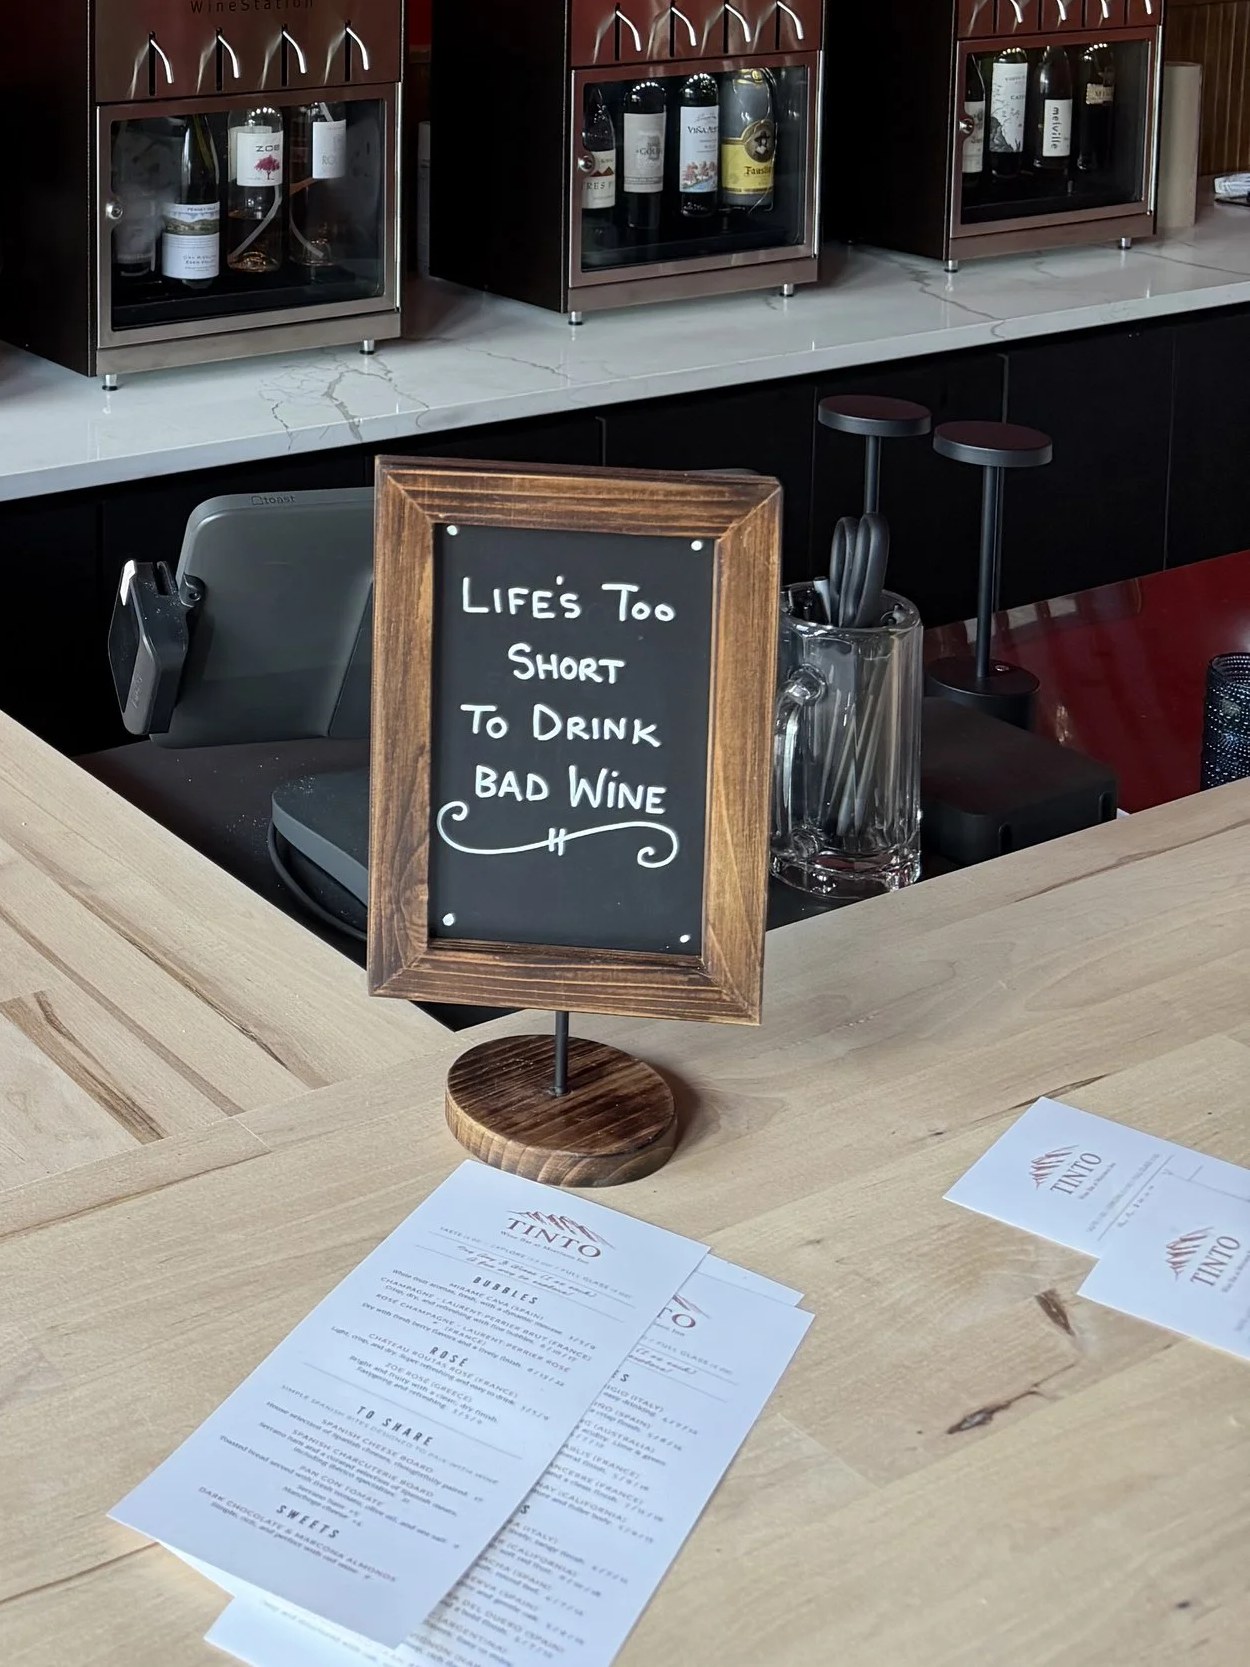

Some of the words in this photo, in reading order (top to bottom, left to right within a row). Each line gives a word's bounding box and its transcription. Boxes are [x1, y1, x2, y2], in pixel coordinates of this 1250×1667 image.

[1051, 107, 1062, 150] melville
[507, 641, 626, 684] SHORT
[533, 703, 662, 748] DRINK
[474, 764, 549, 803] BAD
[1050, 1151, 1103, 1196] TINTO
[507, 1217, 602, 1258] TINTO
[1190, 1234, 1242, 1287] TINTO
[471, 1274, 539, 1305] BUBBLES
[428, 1345, 469, 1367] ROSÉ
[354, 1405, 376, 1419] TO
[379, 1417, 435, 1446] SHARE
[273, 1503, 342, 1540] SWEETS
